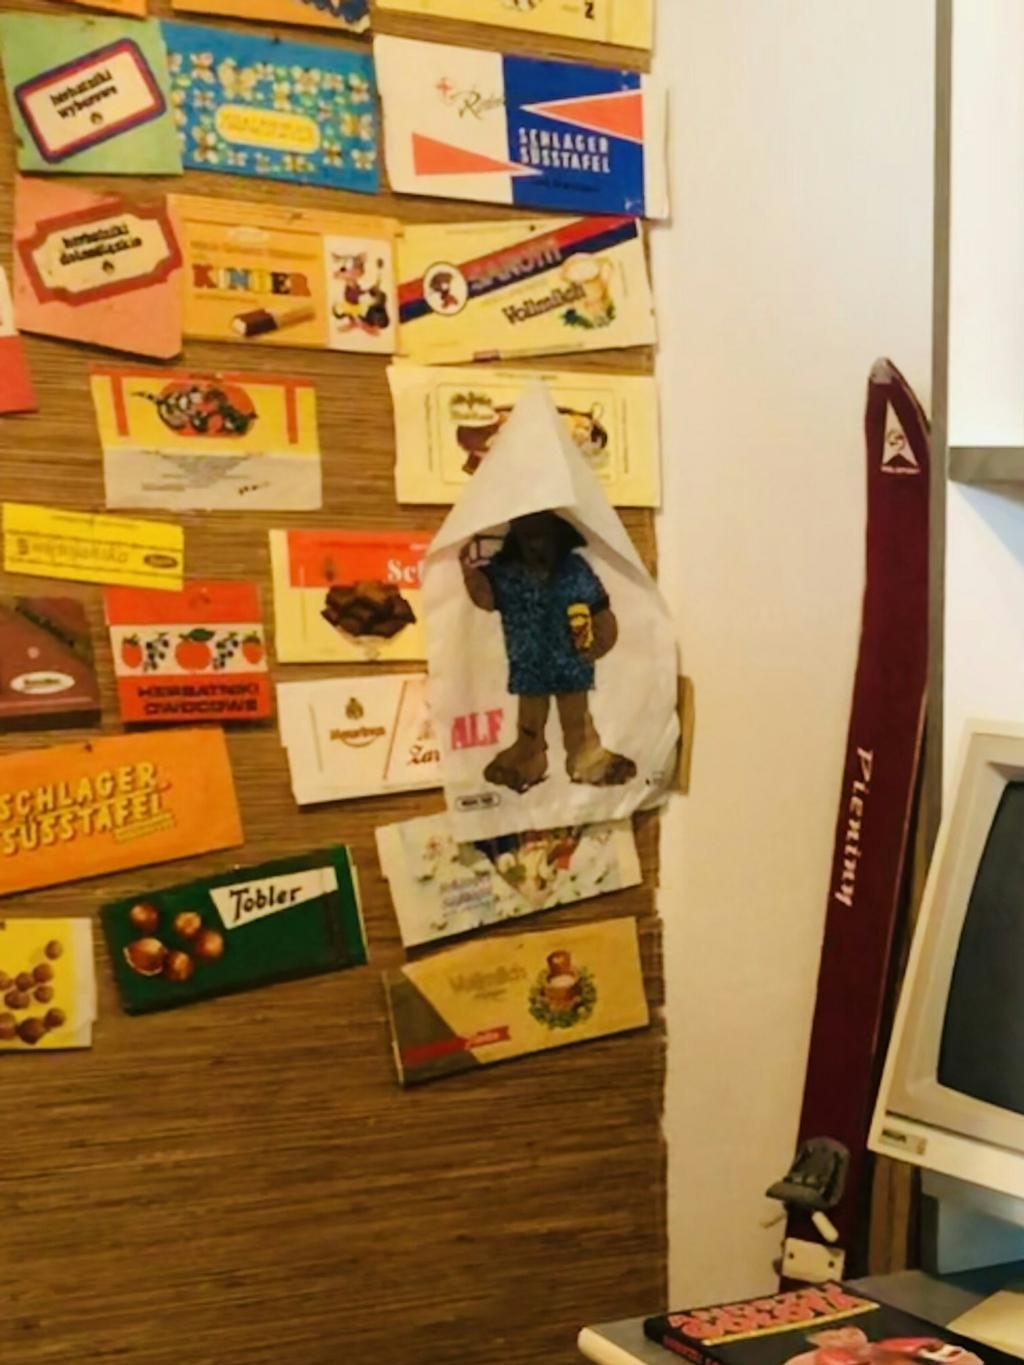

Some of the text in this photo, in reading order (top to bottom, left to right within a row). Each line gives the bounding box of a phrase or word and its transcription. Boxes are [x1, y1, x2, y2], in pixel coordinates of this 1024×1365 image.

[452, 708, 504, 751] ALF
[835, 746, 875, 908] Pieniny
[229, 884, 304, 923] Tobler
